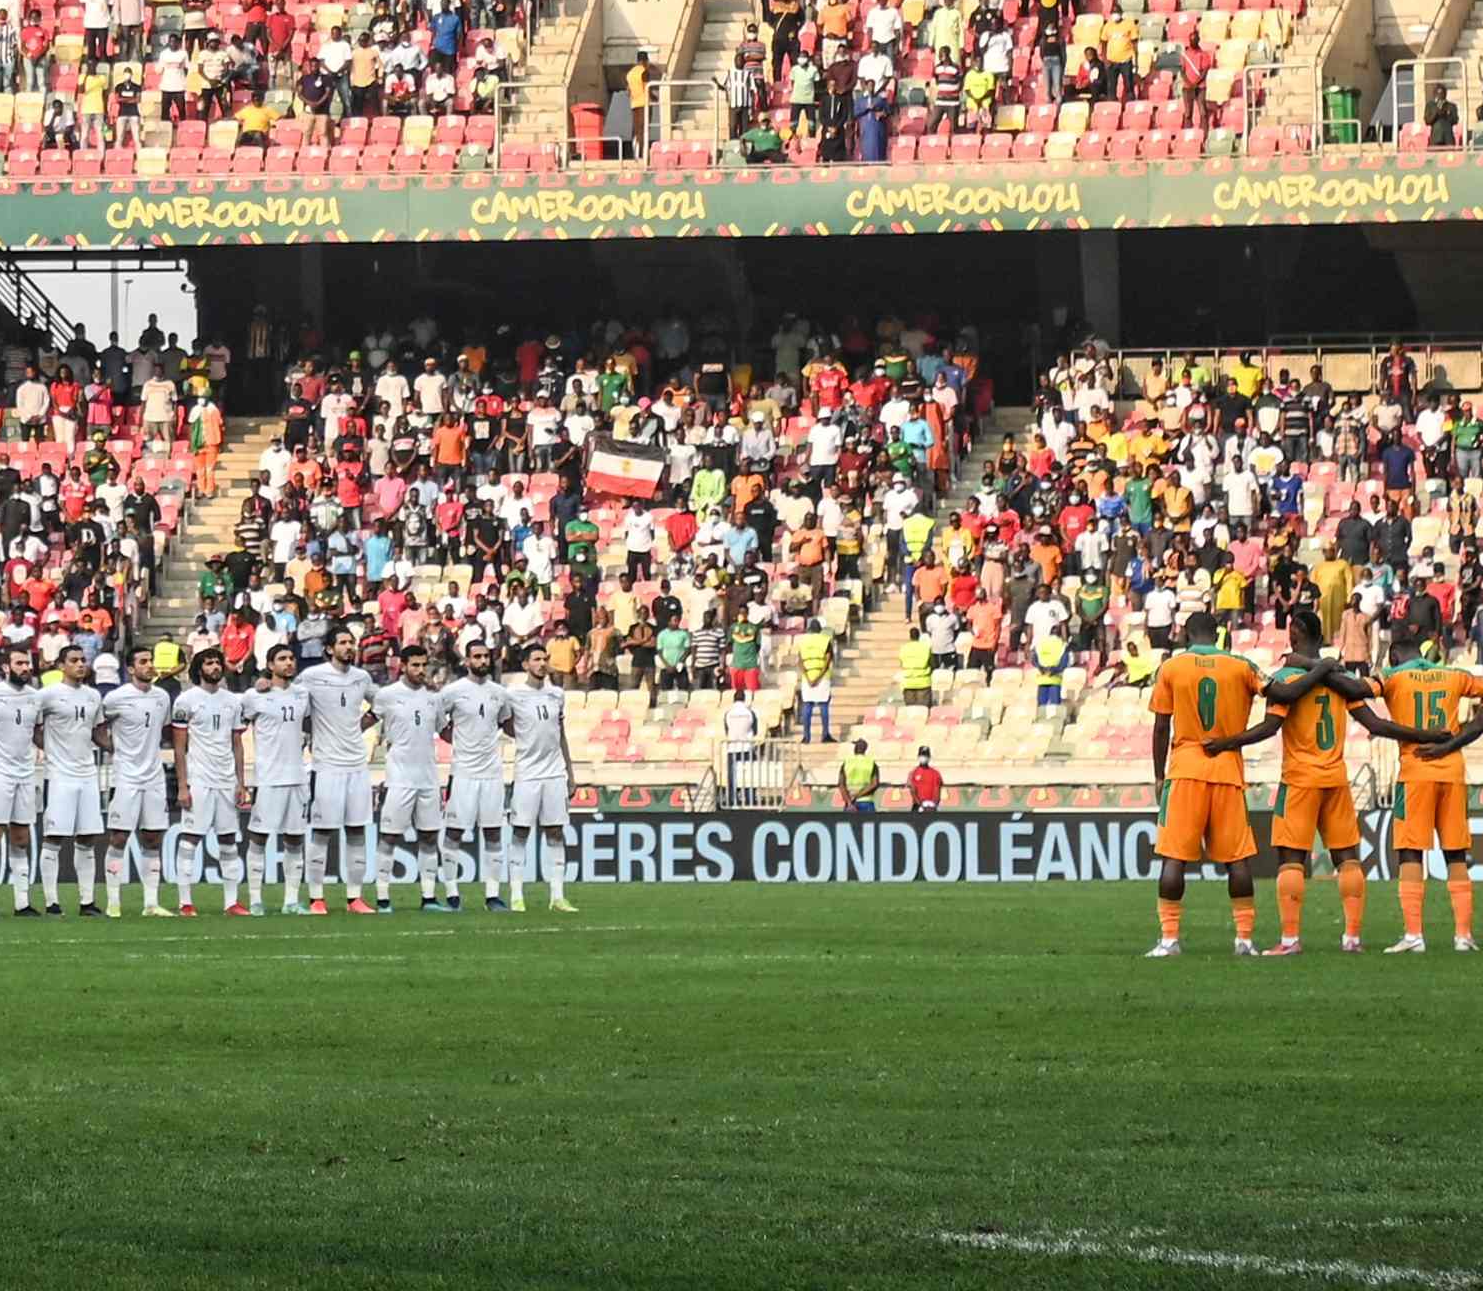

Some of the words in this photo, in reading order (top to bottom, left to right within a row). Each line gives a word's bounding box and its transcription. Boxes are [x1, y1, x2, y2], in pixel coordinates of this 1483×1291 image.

[478, 703, 485, 719] 4
[537, 705, 550, 720] 13
[1197, 676, 1218, 732] 8
[1412, 690, 1447, 731] 15
[74, 705, 85, 721] 14
[281, 706, 295, 722] 22
[414, 709, 422, 726] 5
[1314, 694, 1336, 752] 3
[751, 811, 1231, 883] CONDOLÉANC
